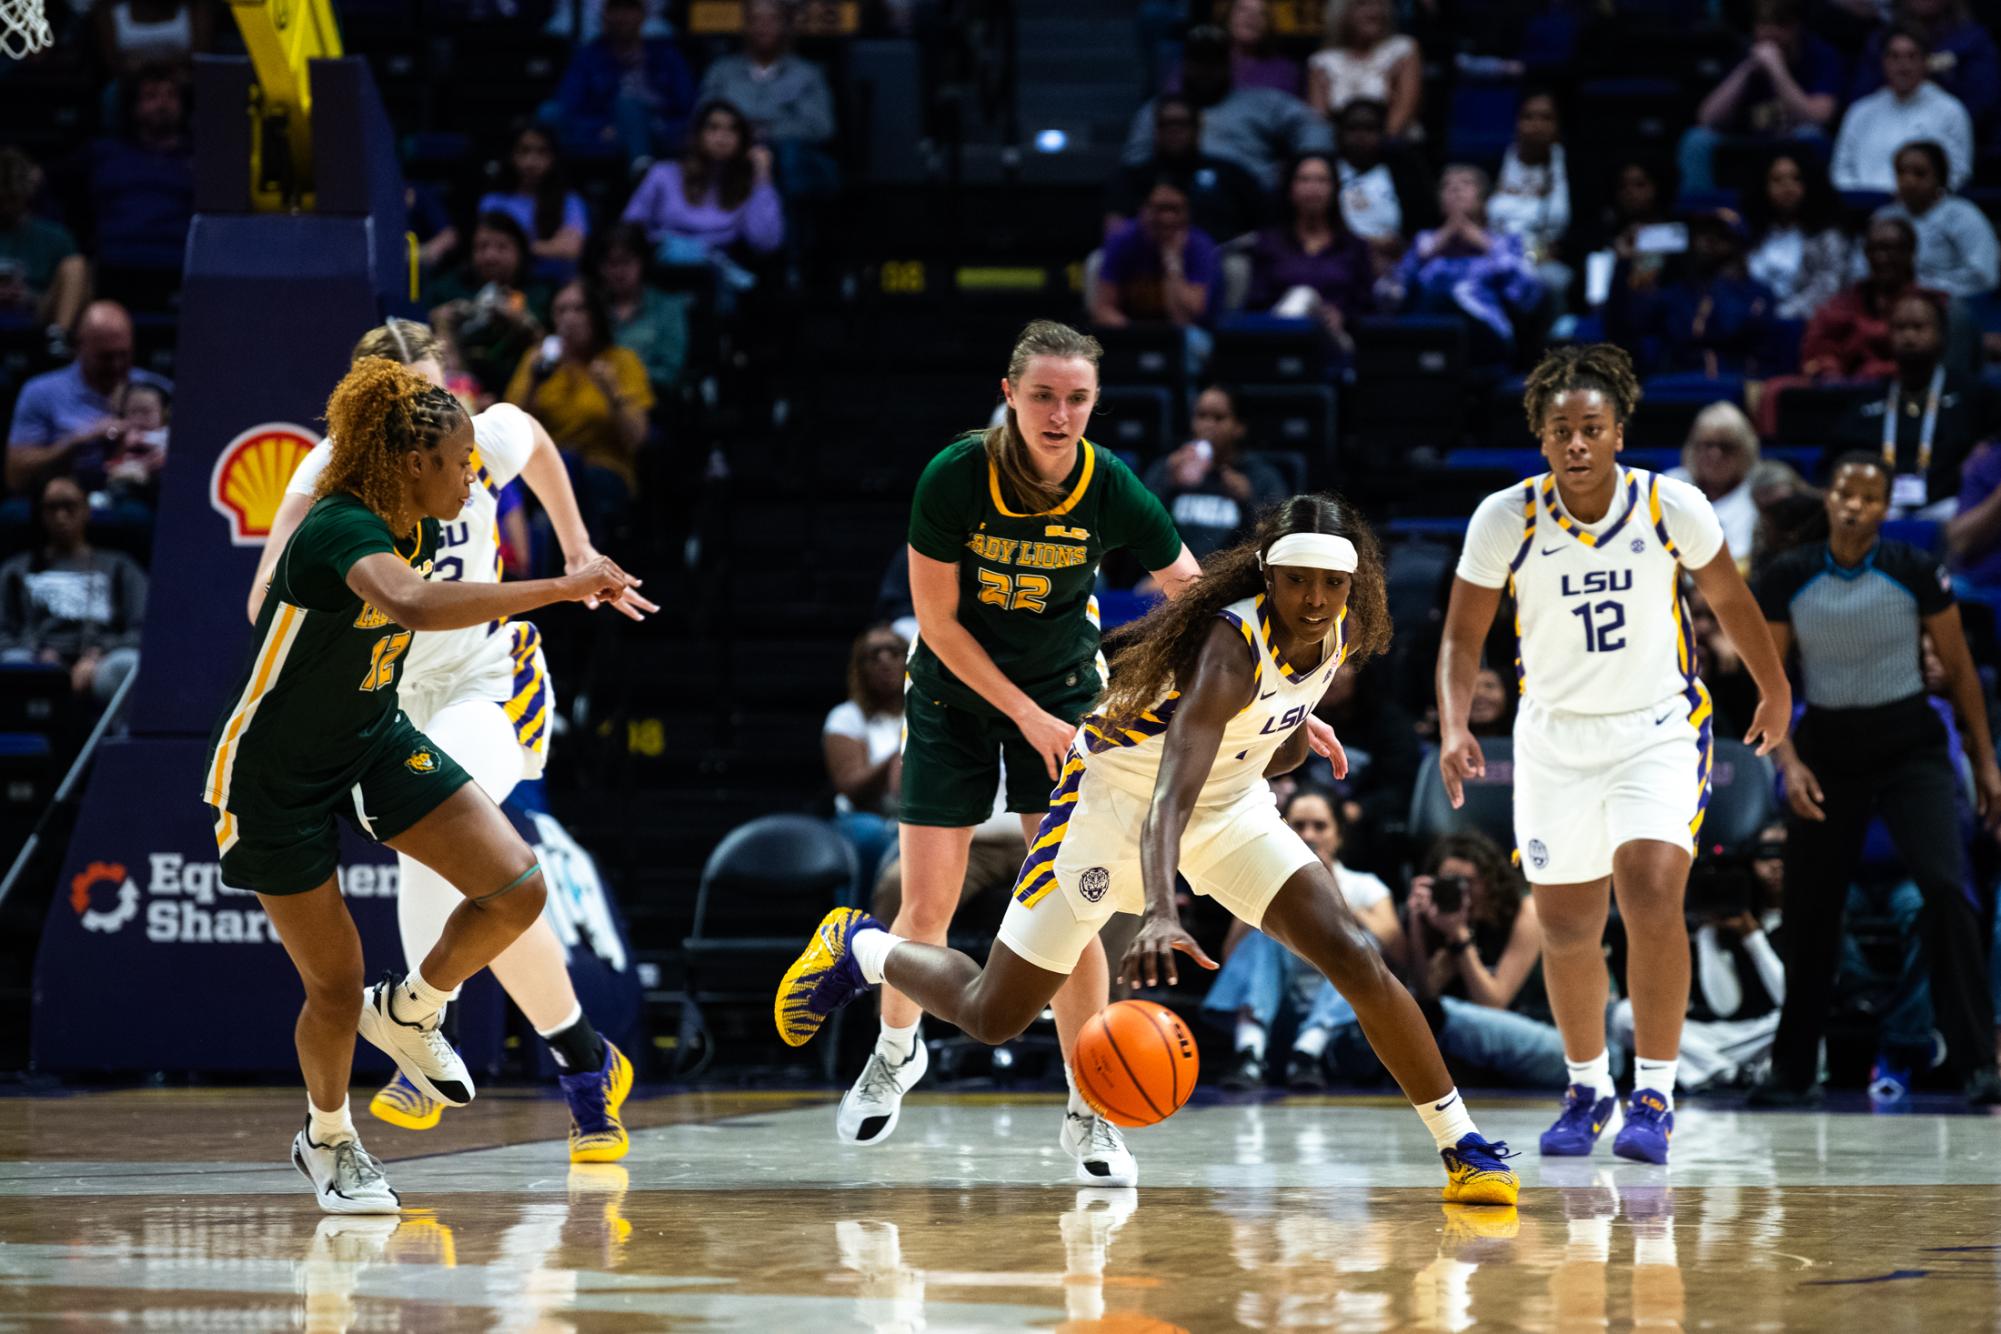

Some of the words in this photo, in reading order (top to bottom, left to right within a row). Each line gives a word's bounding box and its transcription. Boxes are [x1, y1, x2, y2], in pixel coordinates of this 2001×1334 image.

[967, 533, 1019, 565] ADY
[1015, 540, 1088, 569] LIONS
[977, 566, 1051, 614] 22
[1561, 568, 1632, 597] LSU
[1571, 600, 1626, 652] 12
[359, 630, 412, 693] 12
